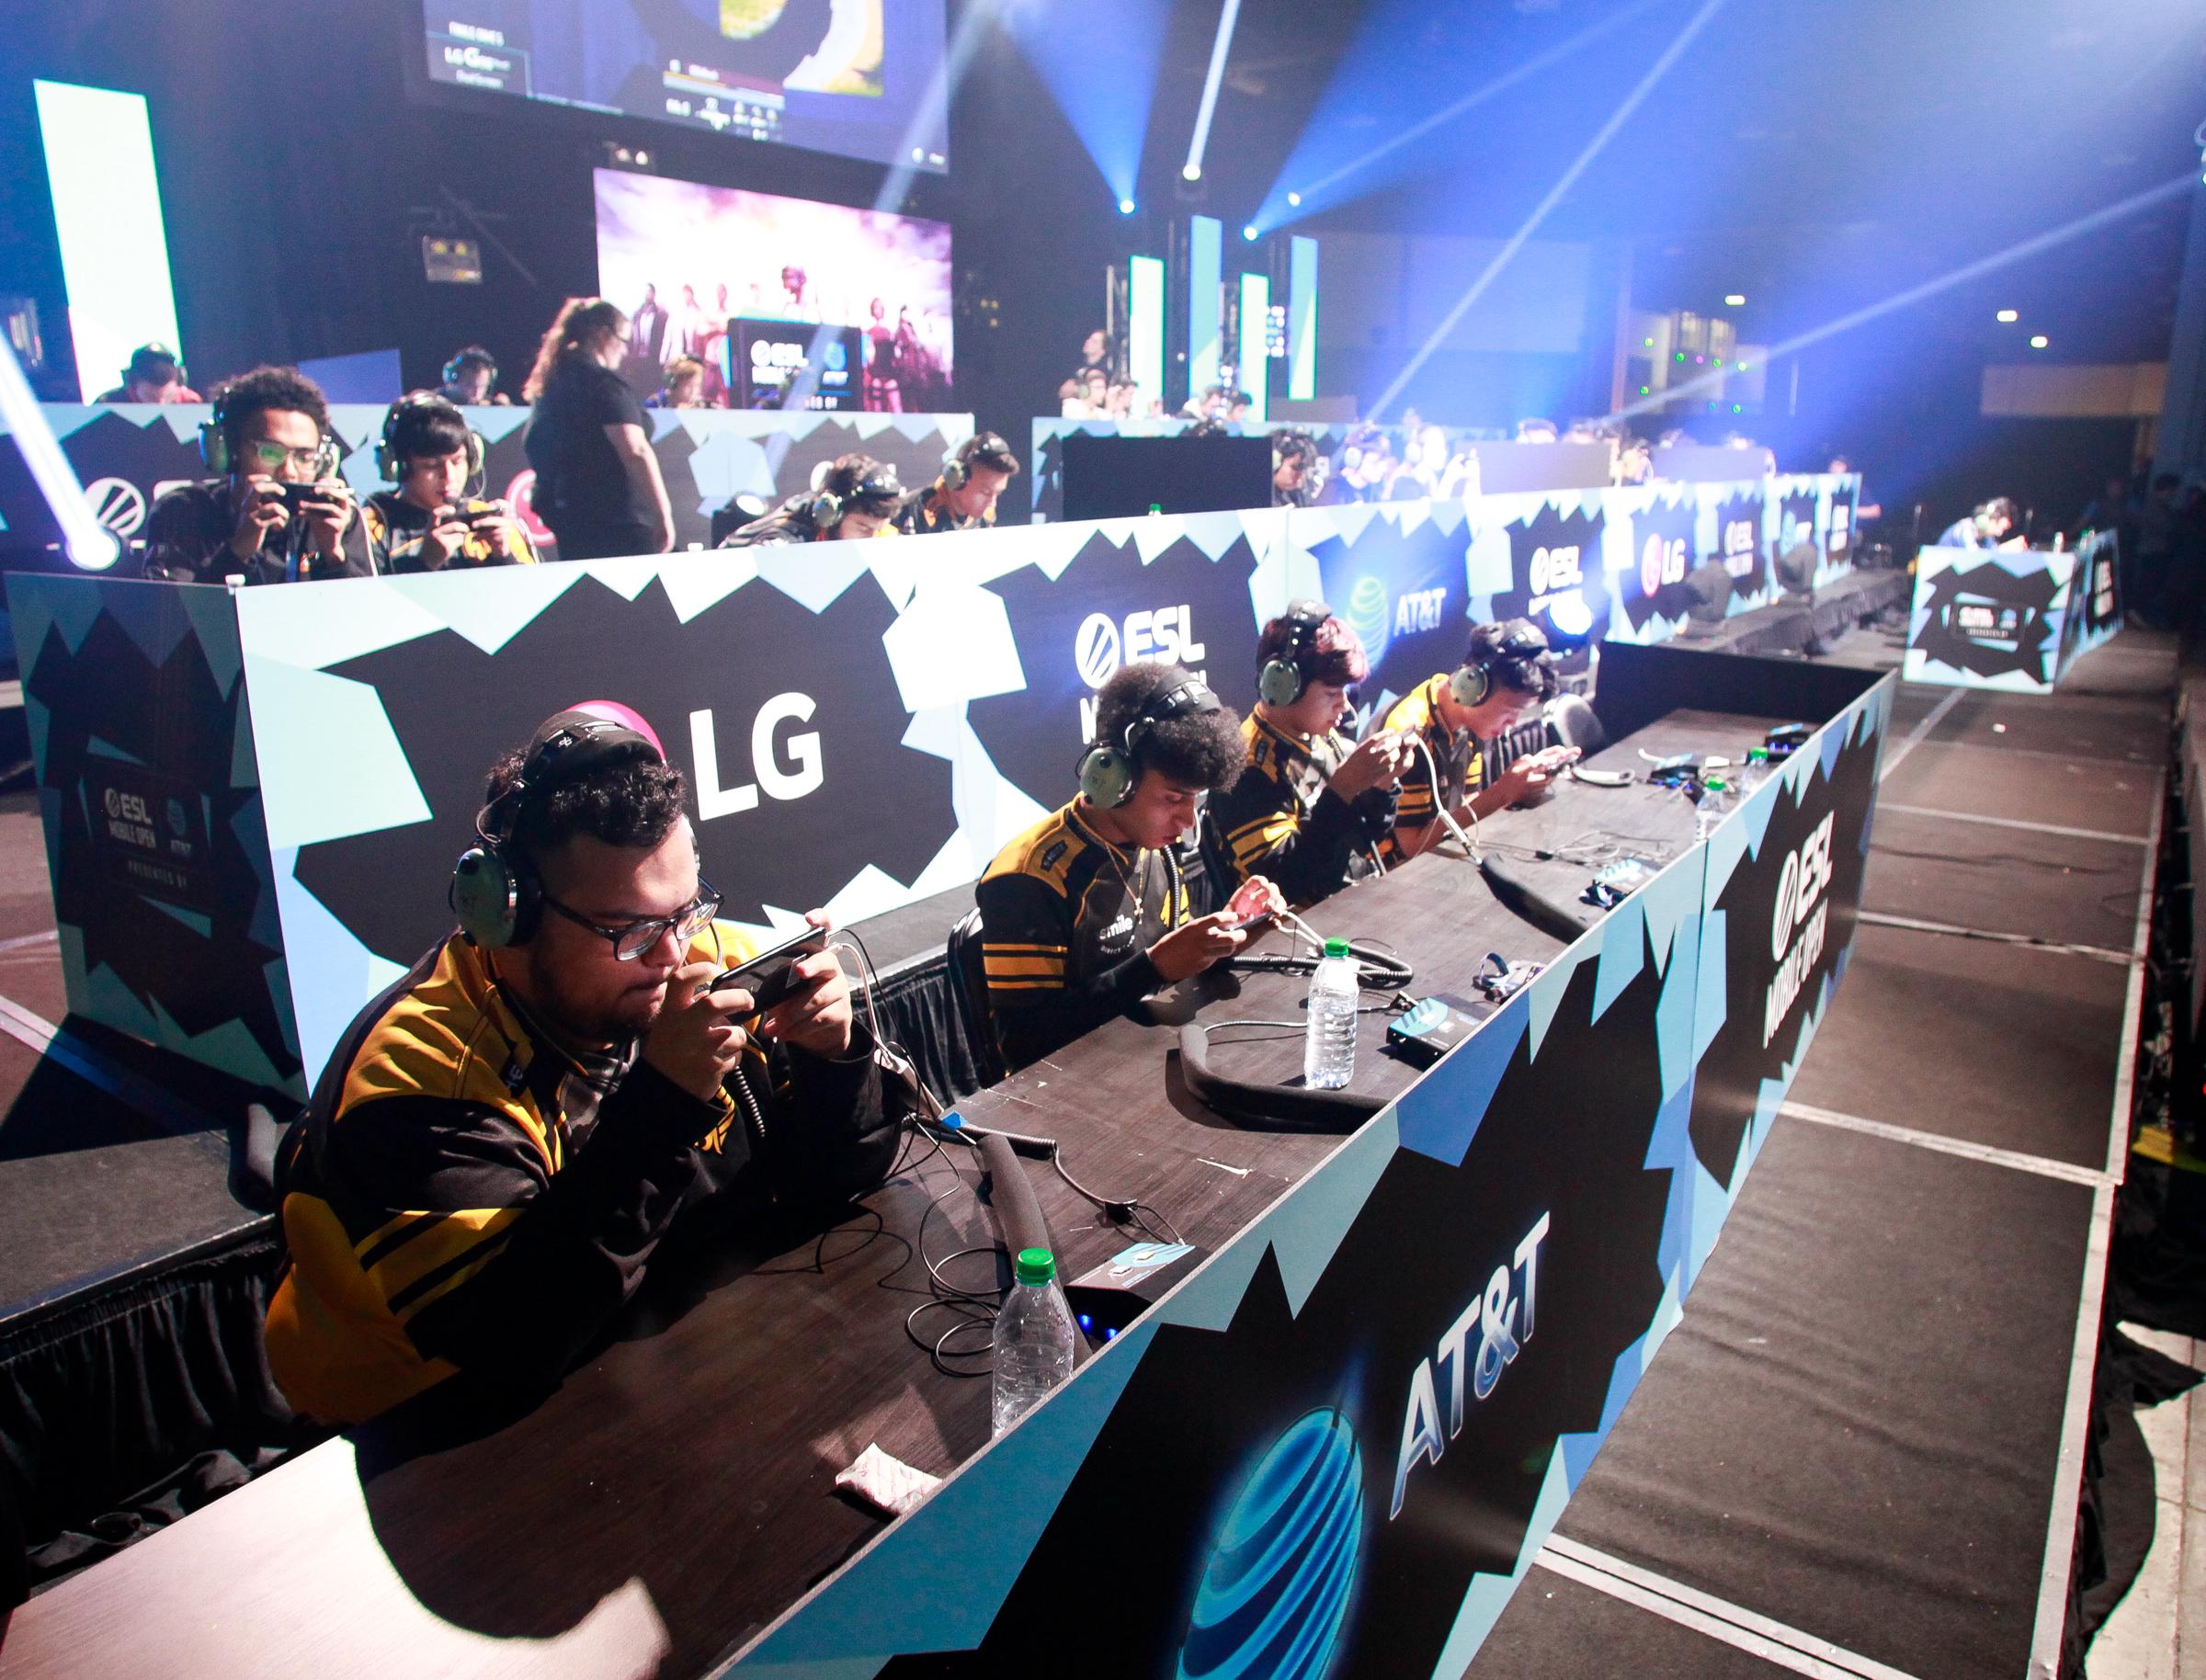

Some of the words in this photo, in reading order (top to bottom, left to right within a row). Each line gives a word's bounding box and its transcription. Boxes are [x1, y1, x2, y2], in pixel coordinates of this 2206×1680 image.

[1548, 545, 1584, 590] ESL
[1660, 537, 1686, 585] LG
[1123, 604, 1206, 667] ESL
[1393, 587, 1448, 637] AT&T
[689, 691, 824, 822] LG
[120, 793, 153, 824] ESL
[1793, 809, 1836, 925] ESL
[1763, 933, 1805, 1050] MOBILE
[1800, 897, 1829, 982] OPEN
[1389, 1209, 1551, 1521] AT&T
